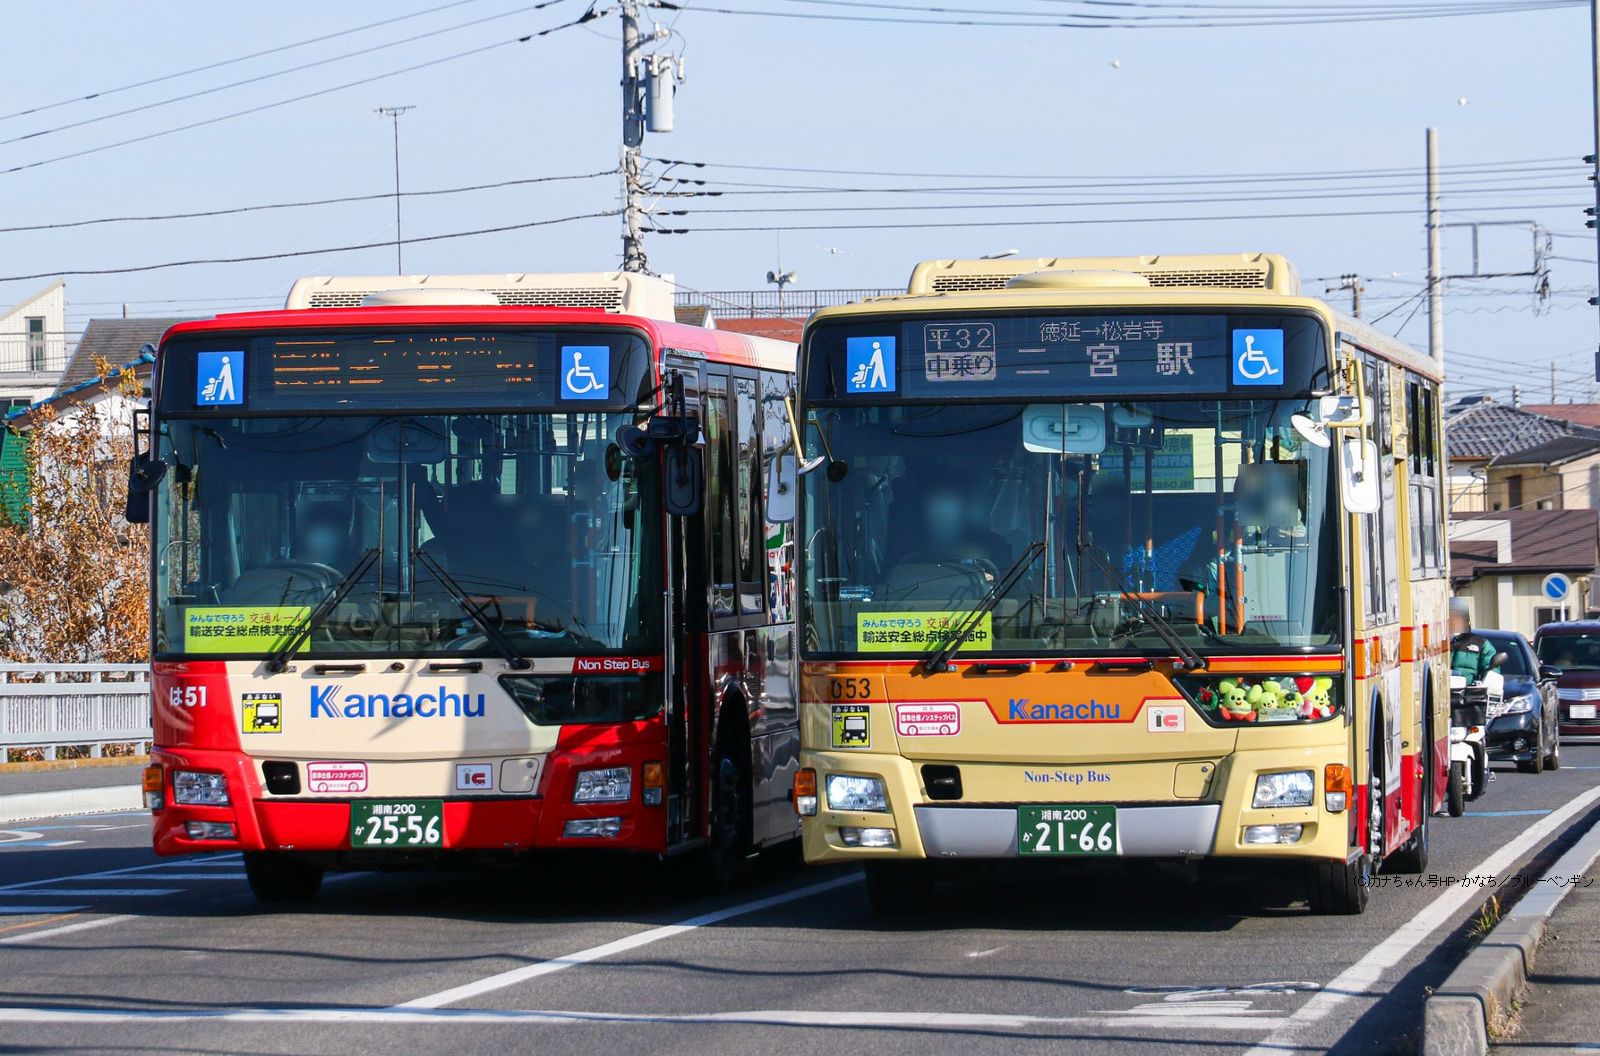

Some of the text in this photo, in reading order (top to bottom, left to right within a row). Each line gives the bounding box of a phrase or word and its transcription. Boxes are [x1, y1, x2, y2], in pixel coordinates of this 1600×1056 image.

[927, 354, 994, 378] 中乗り
[1016, 342, 1196, 377] 二宮駅
[190, 612, 303, 624] みんなで守ろう 交通ルール
[862, 619, 922, 629] みんなで守ろう
[578, 658, 650, 670] Non Step Bus
[169, 686, 207, 707] は51
[310, 685, 485, 718] Kanachu
[1009, 699, 1120, 720] Kanachu
[1024, 771, 1111, 785] Non-Step Bus
[355, 815, 440, 844] か 25-56
[1023, 822, 1112, 851] か 21-66
